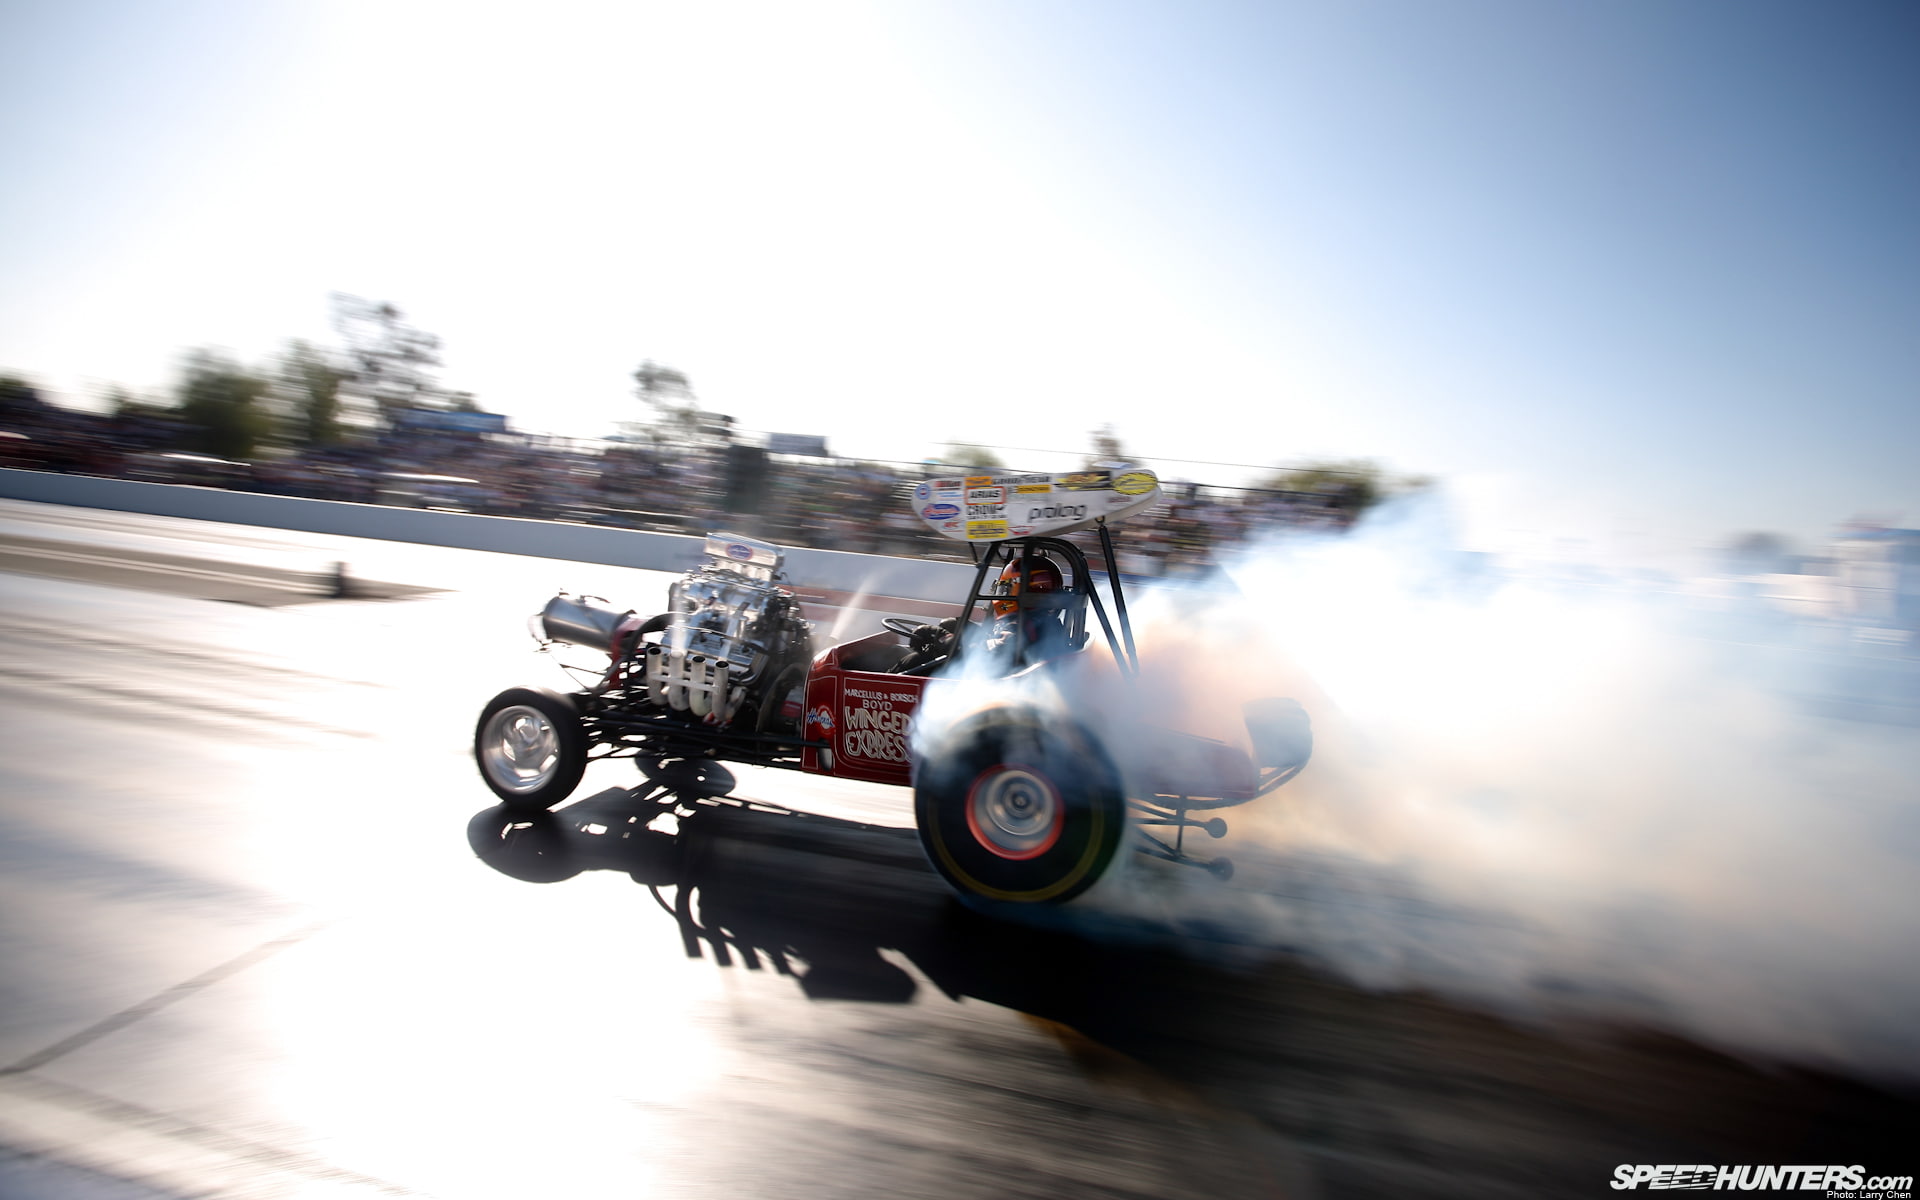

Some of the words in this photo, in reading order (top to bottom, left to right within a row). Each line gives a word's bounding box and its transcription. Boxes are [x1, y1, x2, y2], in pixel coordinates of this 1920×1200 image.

[844, 689, 882, 700] MARCELLUS
[890, 693, 918, 703] BORSCH
[862, 699, 893, 711] BOYD
[844, 706, 915, 736] WINGED
